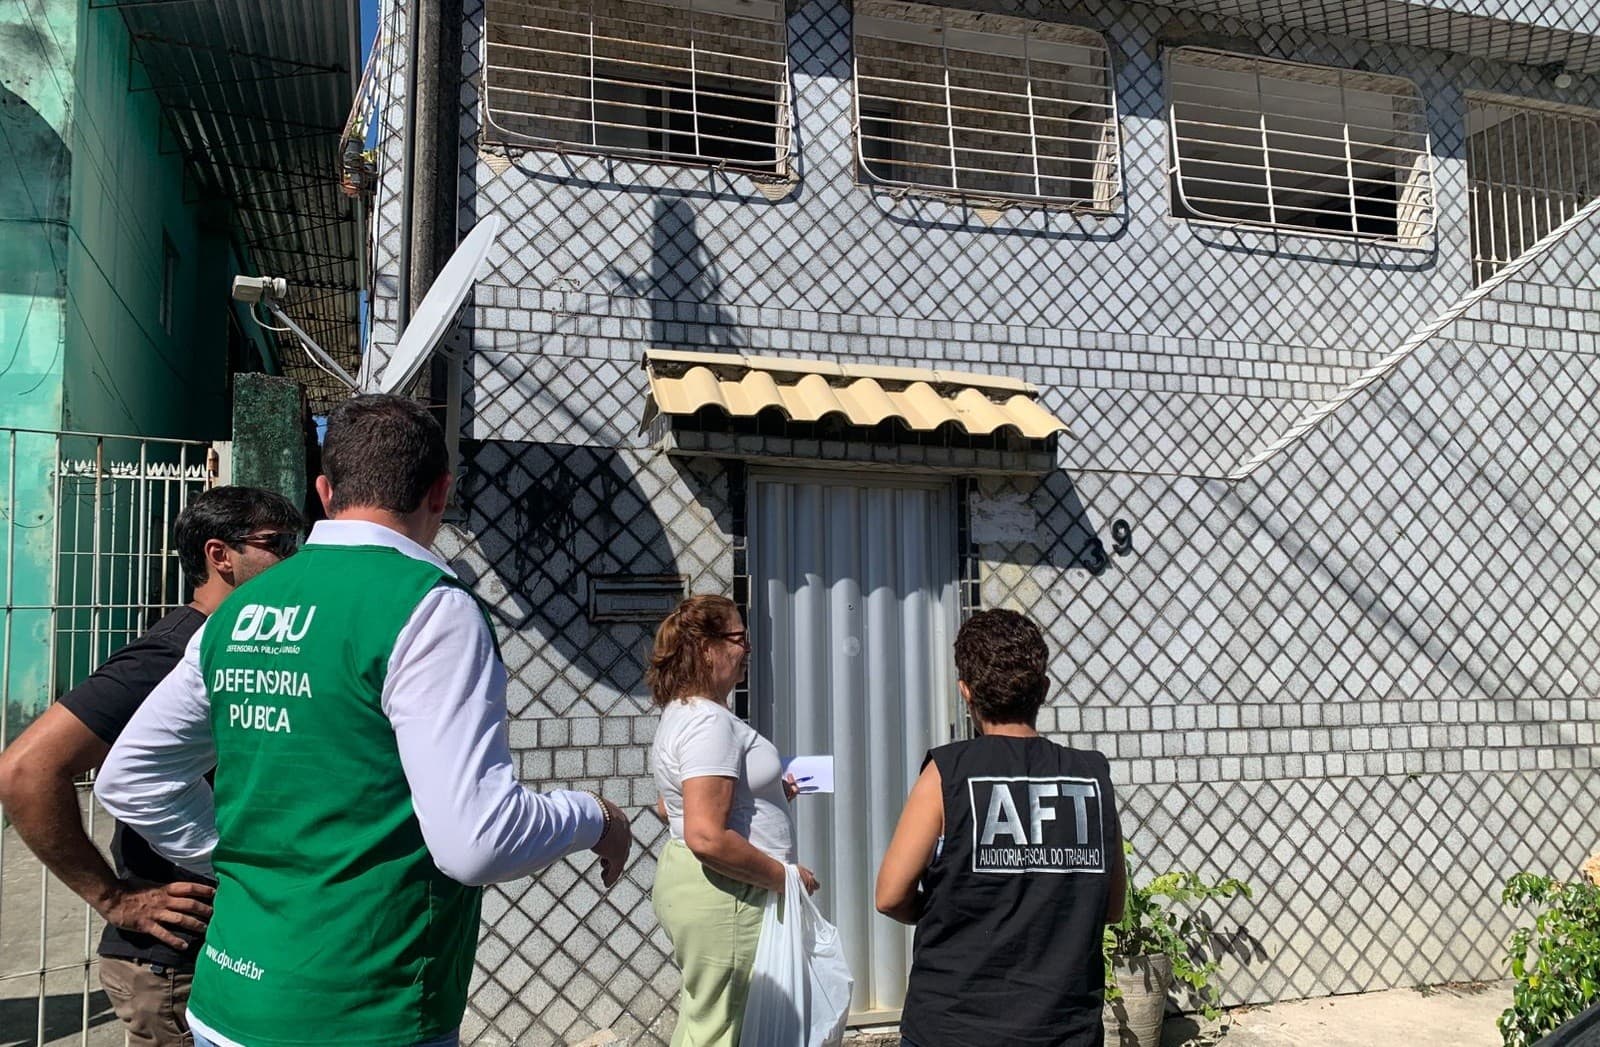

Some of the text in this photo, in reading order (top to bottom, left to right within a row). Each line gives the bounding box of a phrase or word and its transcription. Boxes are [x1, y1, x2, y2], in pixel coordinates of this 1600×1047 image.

[213, 668, 313, 698] DEFENSORIA
[980, 783, 1096, 845] AFT
[1050, 847, 1064, 867] DO
[1064, 847, 1100, 866] TRABALHO
